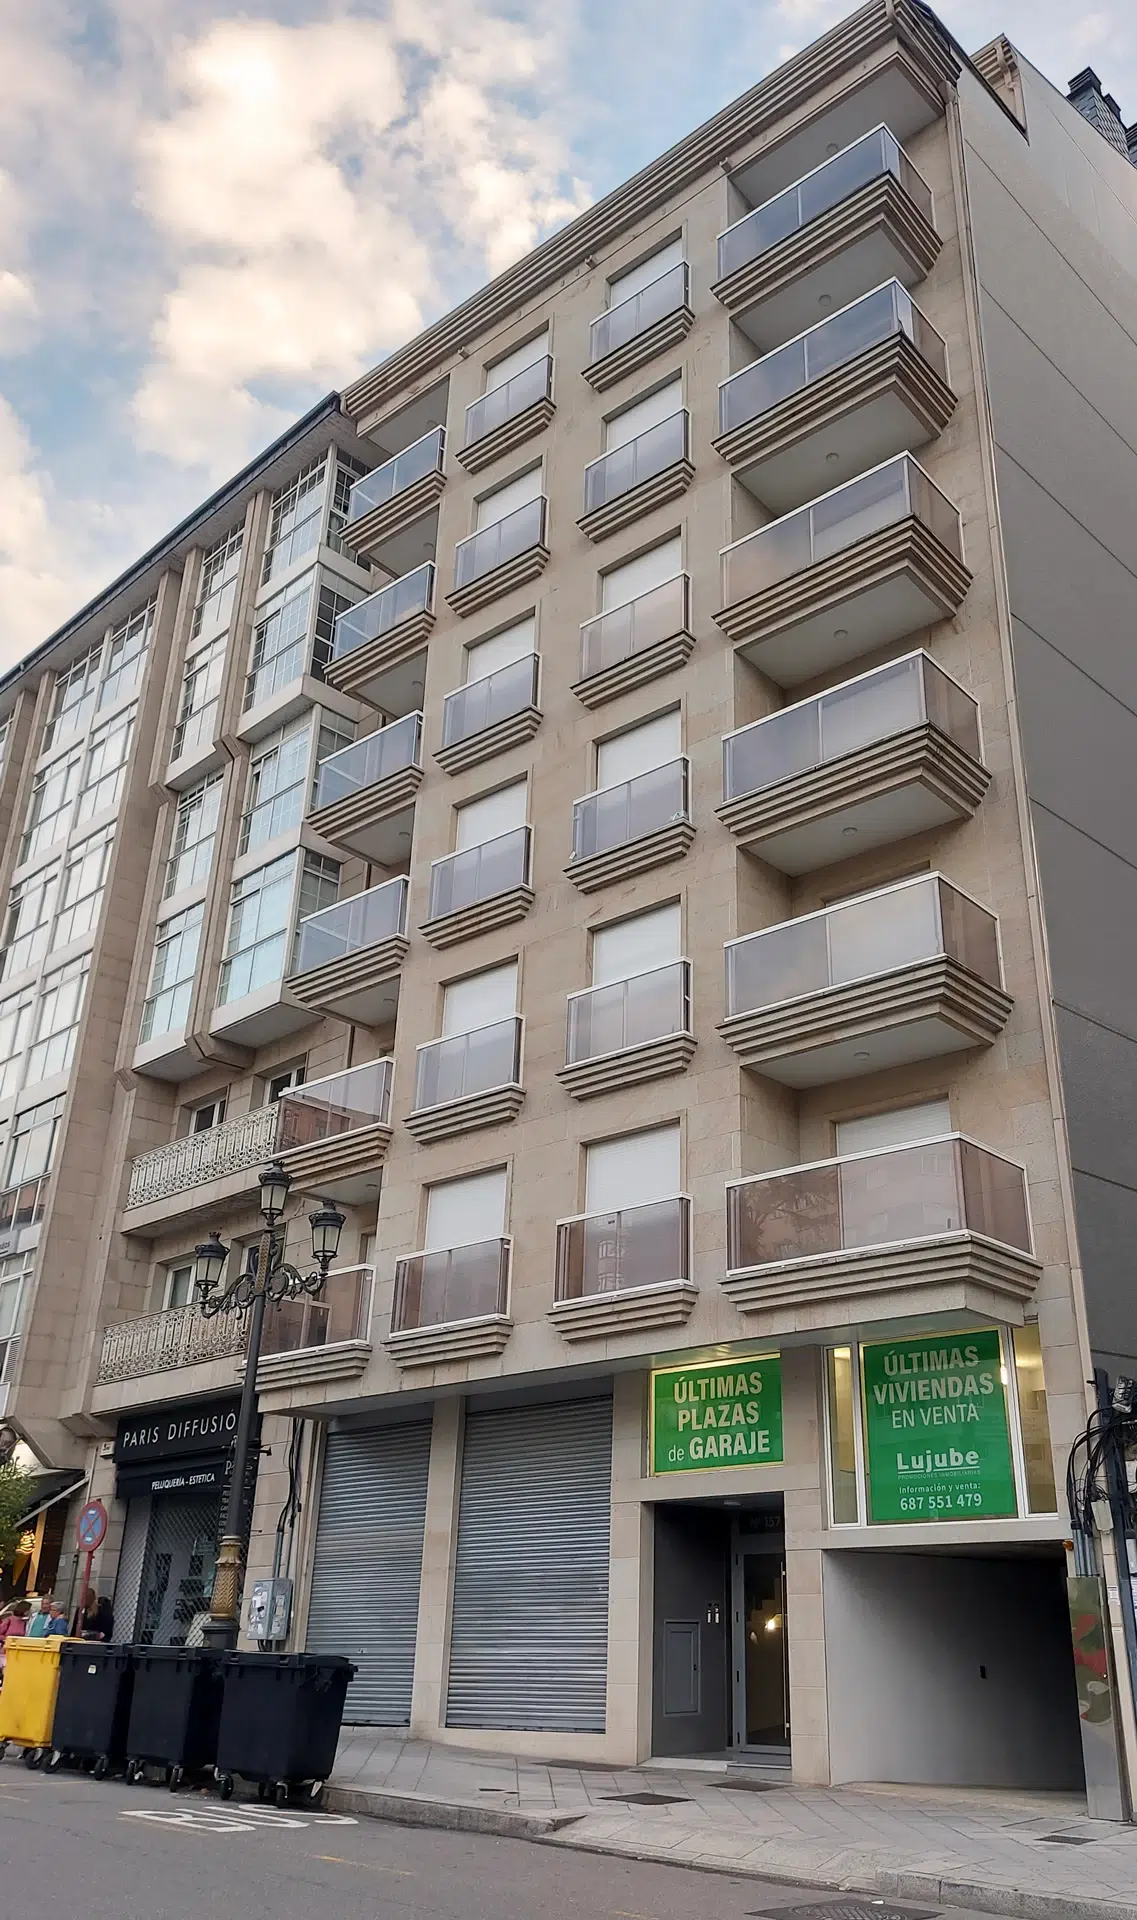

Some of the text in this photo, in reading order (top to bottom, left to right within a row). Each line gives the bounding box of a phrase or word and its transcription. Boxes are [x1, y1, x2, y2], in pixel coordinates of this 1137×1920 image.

[884, 1346, 978, 1376] ÚLTIMAS
[674, 1371, 762, 1404] ÚLTIMAS
[873, 1372, 994, 1405] VIVIENDAS
[122, 1409, 236, 1448] PARIS DIFFUSIÓ
[678, 1401, 759, 1432] PLAZAS
[892, 1403, 979, 1428] EN VENTA
[668, 1430, 770, 1462] de GARAJE
[897, 1448, 979, 1473] Lujube
[899, 1482, 981, 1494] Información y venta:
[900, 1493, 982, 1511] 687 551 479
[119, 1804, 359, 1832] BUS
